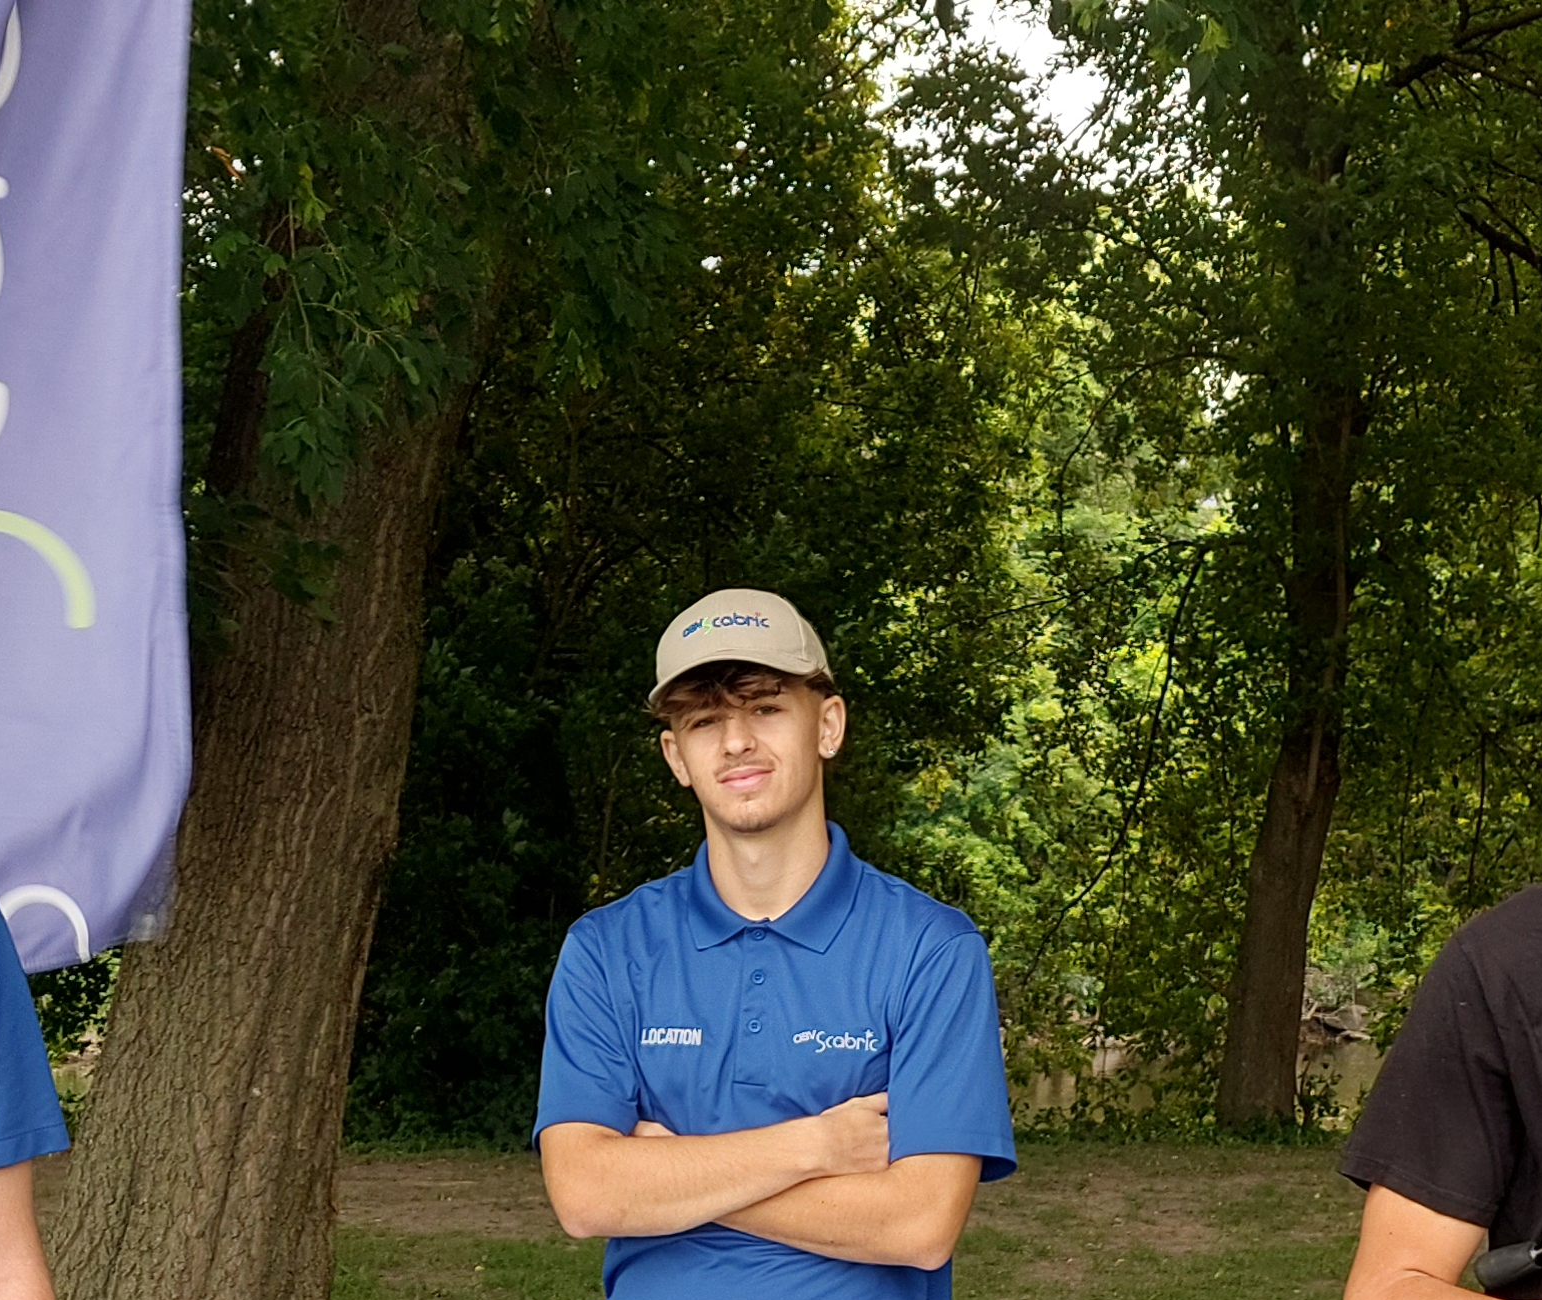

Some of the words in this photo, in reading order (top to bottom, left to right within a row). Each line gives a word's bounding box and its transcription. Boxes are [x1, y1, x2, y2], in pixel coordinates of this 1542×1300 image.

[640, 1028, 703, 1045] LOCATION
[792, 1029, 817, 1044] OBV
[815, 1029, 879, 1053] Scabric
